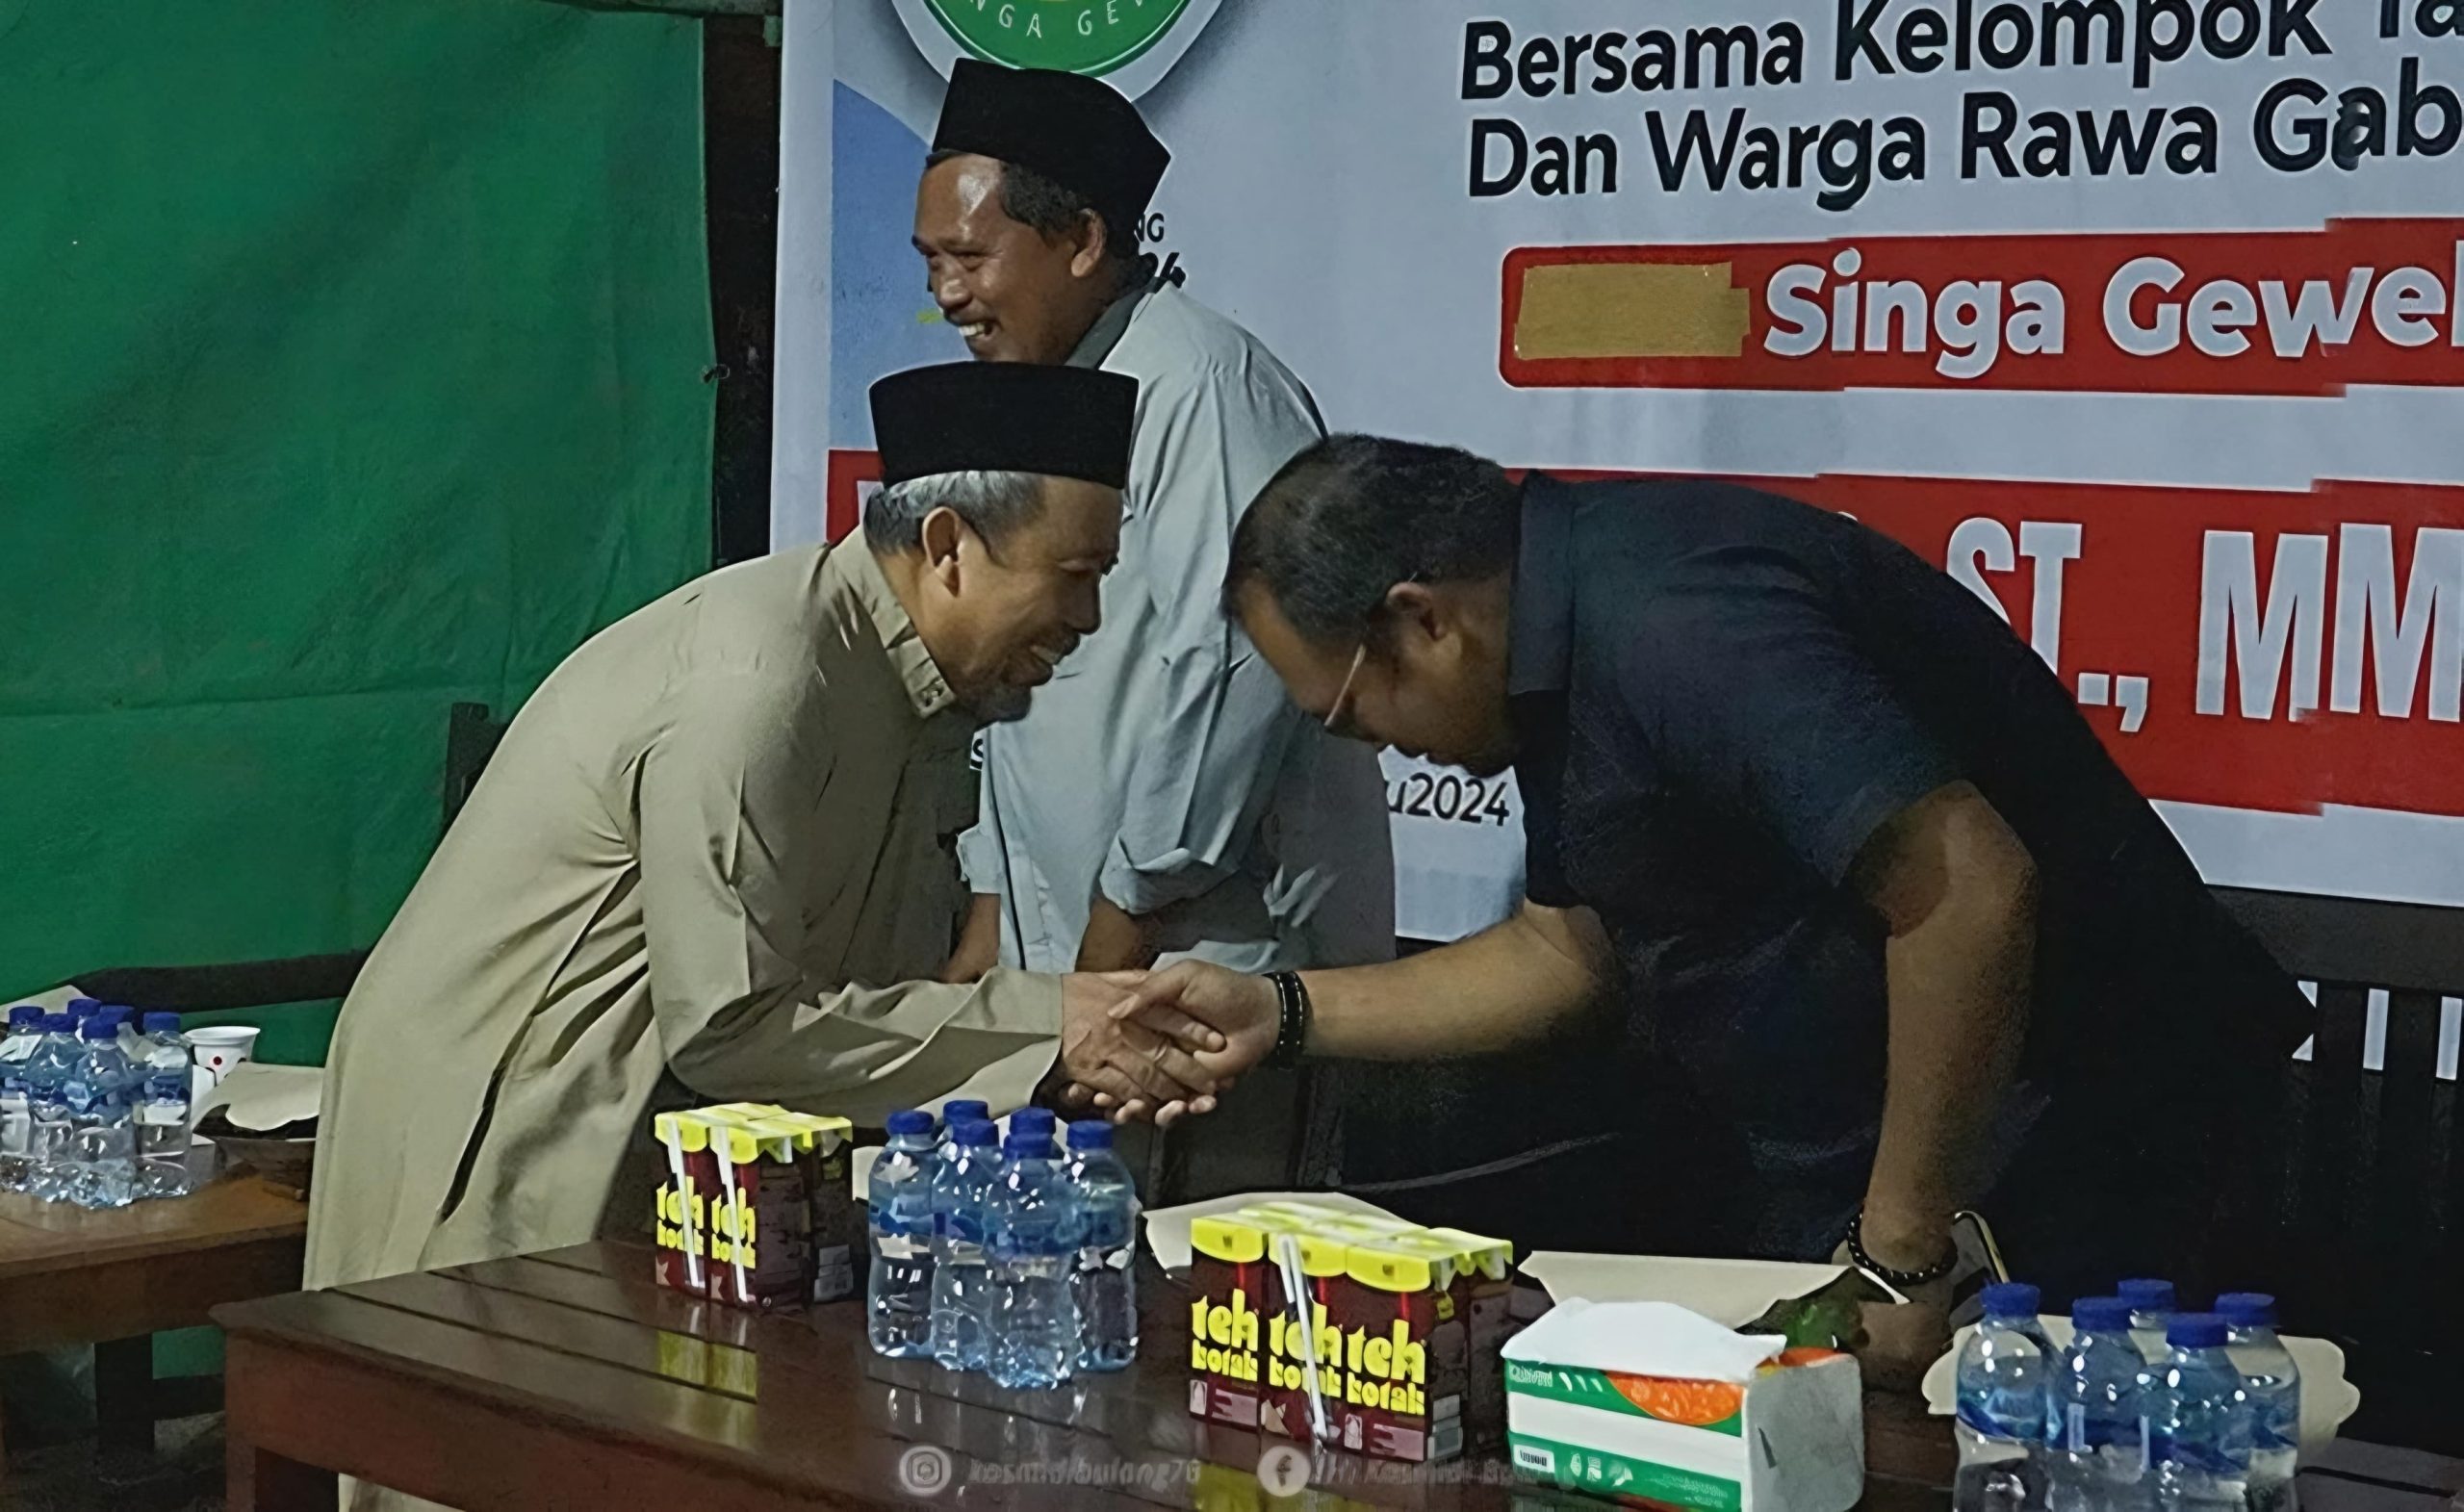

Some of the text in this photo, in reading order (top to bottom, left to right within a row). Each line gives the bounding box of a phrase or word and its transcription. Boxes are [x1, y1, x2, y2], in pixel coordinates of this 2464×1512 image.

[1461, 20, 1804, 99] Bersama
[1835, 0, 2333, 89] Kelompok
[1469, 118, 1617, 196] Dan
[1645, 108, 1925, 212] Warga
[1961, 91, 2218, 179] Rawa
[1763, 247, 2065, 378] Singa
[1385, 772, 1510, 827] u2024
[1192, 1288, 1259, 1351] teh
[1348, 1319, 1425, 1384] teh
